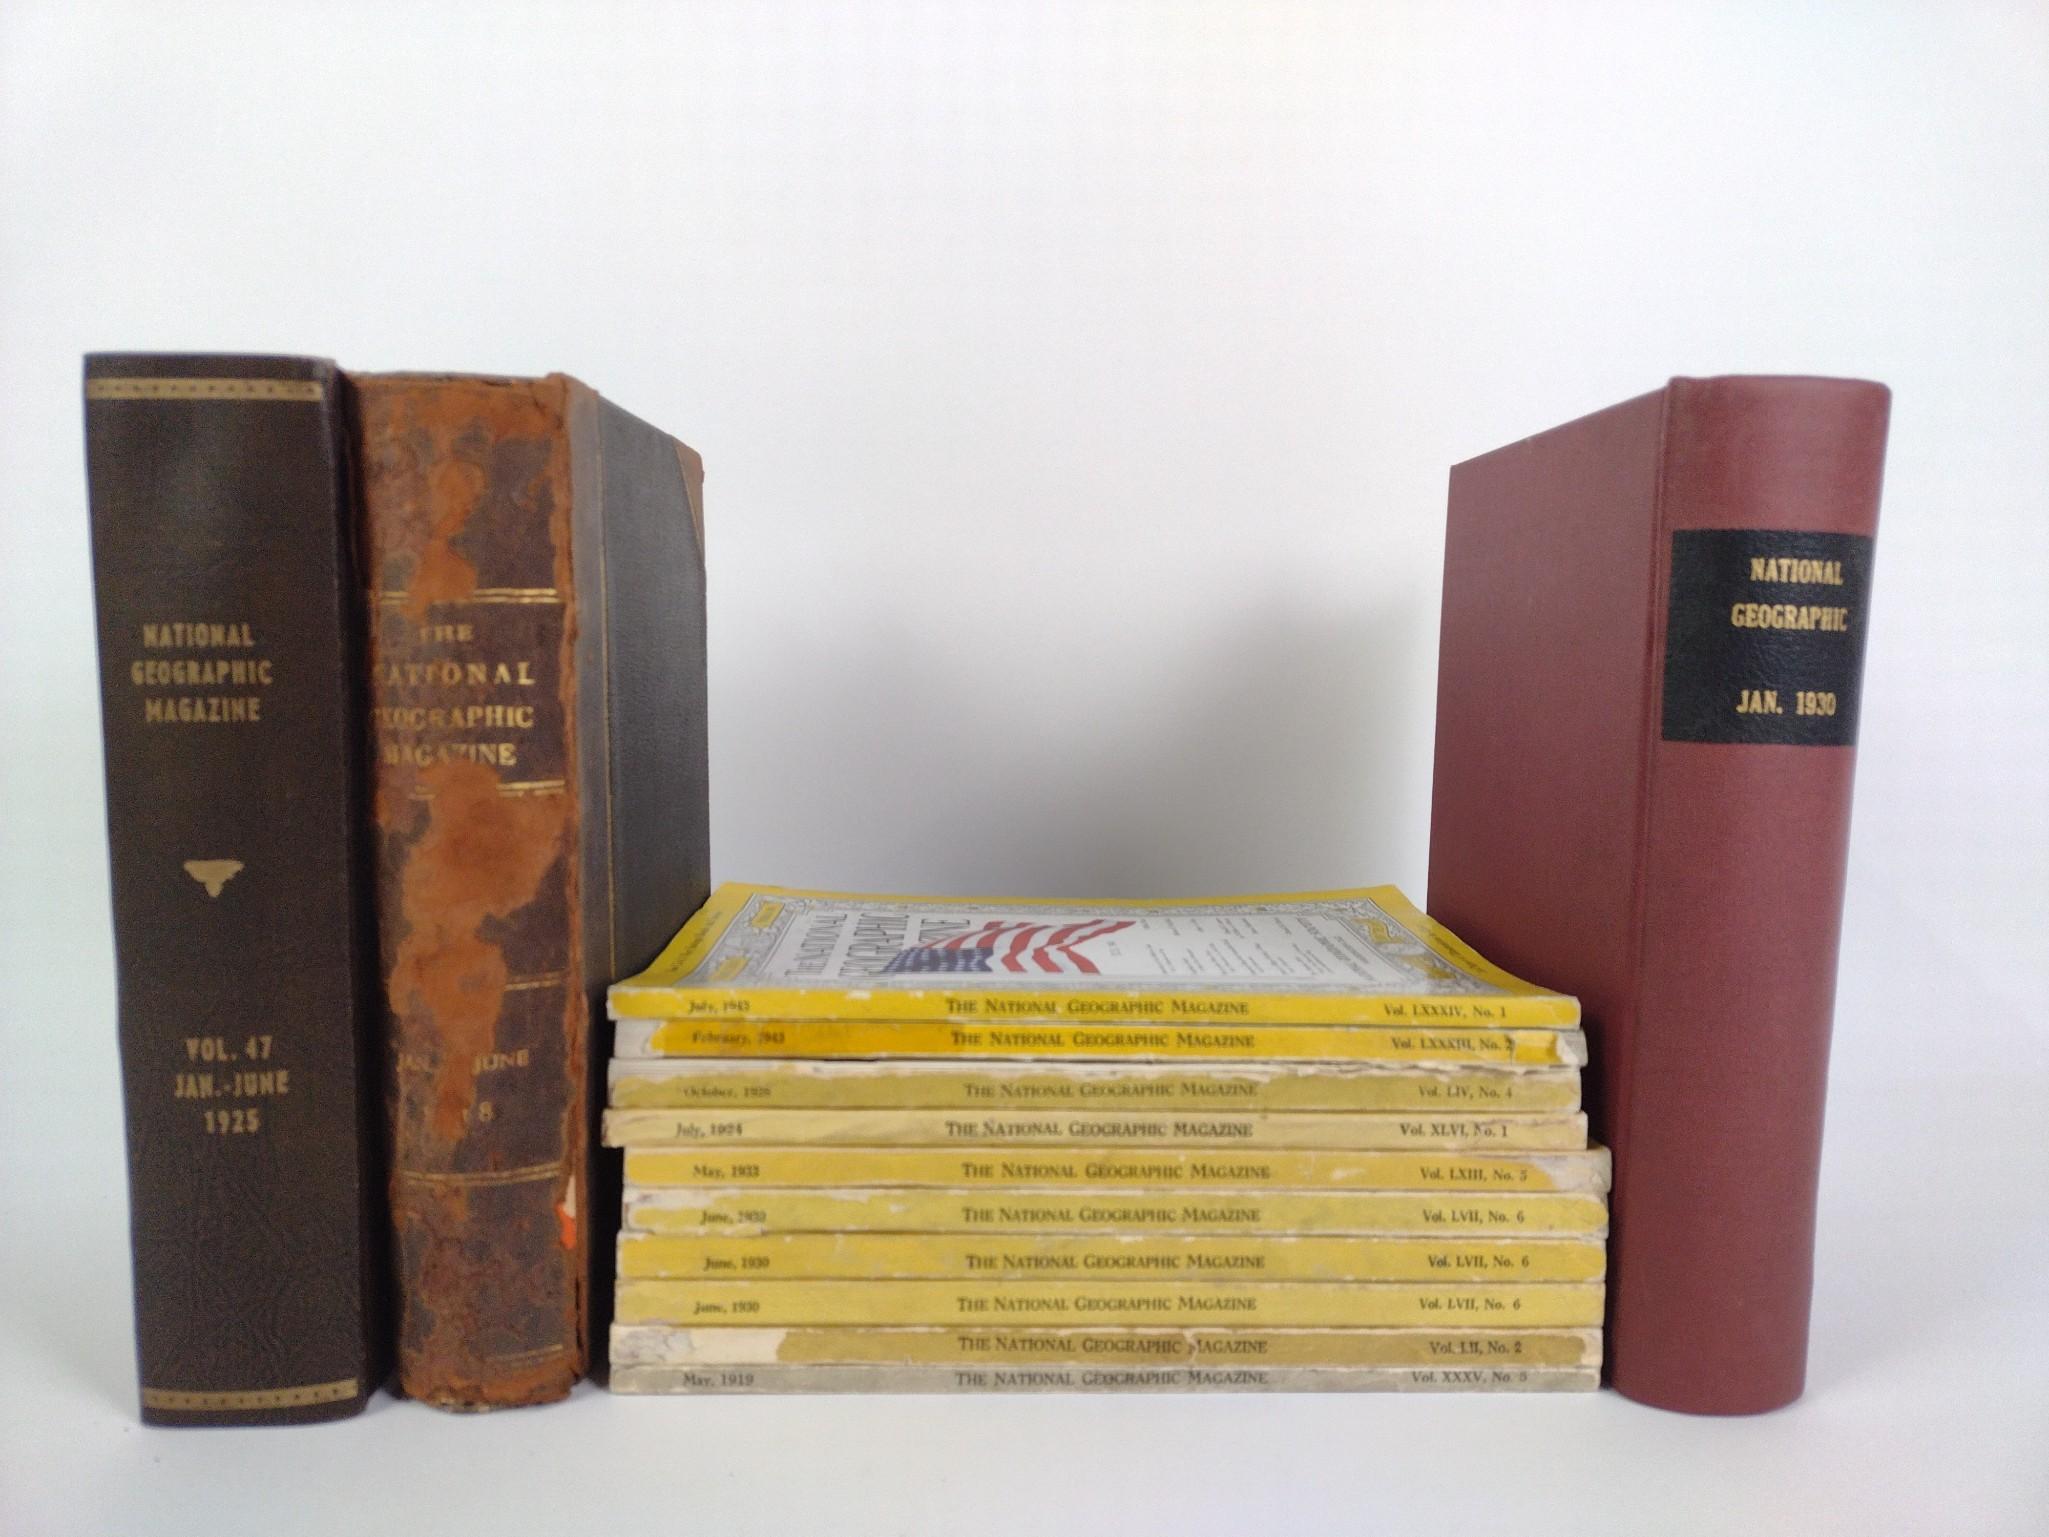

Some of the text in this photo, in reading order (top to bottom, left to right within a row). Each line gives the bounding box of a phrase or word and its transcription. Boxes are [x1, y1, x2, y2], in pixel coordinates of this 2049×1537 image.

[1750, 557, 1843, 585] NATIONAL
[1731, 603, 1848, 632] GEOGRAPHIC
[143, 623, 255, 648] NATIONAL
[131, 660, 273, 685] GEOGRAPHIC
[374, 661, 536, 686] ATIONAL
[145, 697, 260, 722] MAGAZINE
[1736, 689, 1837, 716] JAN. 1930
[946, 999, 976, 1013] THE
[985, 999, 1058, 1014] NATIONAL
[1067, 999, 1163, 1014] GEOGRAPHIC
[1171, 999, 1249, 1015] MAGAZINE
[1384, 1004, 1406, 1016] Vol.
[1413, 1004, 1467, 1018] LXXXIV,
[1473, 1005, 1493, 1017] No.
[1500, 1005, 1507, 1017] 1
[186, 1034, 273, 1061] VOL. 47
[951, 1030, 981, 1047] THE
[990, 1031, 1064, 1047] NATIONAL
[1073, 1031, 1169, 1047] GEOGRAPHIC
[1176, 1032, 1255, 1048] MAGAZINE
[1392, 1037, 1415, 1049] Vol.
[1480, 1038, 1499, 1050] No.
[964, 1083, 994, 1098] THE
[1000, 1084, 1074, 1098] NATIONAL
[1080, 1082, 1174, 1097] GEOGRAPHIC
[1180, 1082, 1258, 1097] MAGAZINE
[1419, 1086, 1440, 1097] Vol.
[1447, 1086, 1473, 1099] LIV,
[1479, 1086, 1499, 1098] No.
[1505, 1086, 1513, 1098] 4
[204, 1108, 261, 1134] 1925
[676, 1122, 705, 1137] July,
[945, 1120, 977, 1136] THE
[983, 1120, 1062, 1136] NATIONAL
[1069, 1120, 1165, 1137] GEOGRAPHIC
[1173, 1122, 1252, 1137] MAGAZINE
[1400, 1124, 1424, 1137] Vol.
[1430, 1124, 1469, 1138] XLVI,
[1473, 1125, 1496, 1137] No.
[1501, 1125, 1508, 1137] 1
[693, 1164, 725, 1179] May,
[961, 1162, 993, 1178] THE
[1002, 1162, 1076, 1178] NATIONAL
[1085, 1163, 1182, 1178] GEOGRAPHIC
[1190, 1163, 1270, 1179] MAGAZINE
[1420, 1168, 1443, 1180] Vol.
[1449, 1168, 1487, 1182] LXIII,
[1493, 1168, 1514, 1180] No.
[1519, 1169, 1527, 1181] 5
[700, 1210, 733, 1224] June,
[962, 1206, 993, 1223] THE
[1000, 1207, 1073, 1223] NATIONAL
[1079, 1207, 1176, 1223] GEOGRAPHIC
[1182, 1207, 1260, 1223] MAGAZINE
[1423, 1210, 1446, 1223] Vol.
[1451, 1210, 1483, 1224] LVII,
[1488, 1210, 1509, 1222] No.
[1516, 1210, 1525, 1222] 6
[704, 1256, 736, 1271] June,
[966, 1254, 997, 1269] THE
[1003, 1254, 1077, 1270] NATIONAL
[1084, 1254, 1180, 1270] GEOGRAPHIC
[1186, 1254, 1265, 1270] MAGAZINE
[1428, 1255, 1451, 1268] Vol.
[1456, 1255, 1488, 1269] LVII,
[1493, 1255, 1514, 1268] No.
[1521, 1255, 1529, 1267] 6
[694, 1302, 727, 1316] June,
[957, 1297, 988, 1312] THE
[994, 1297, 1068, 1312] NATIONAL
[1075, 1297, 1170, 1311] GEOGRAPHIC
[1177, 1296, 1256, 1311] MAGAZINE
[1419, 1298, 1442, 1310] Vol.
[1447, 1298, 1479, 1311] LVII,
[1484, 1298, 1505, 1310] No.
[1512, 1298, 1521, 1310] 6
[958, 1336, 990, 1351] THE
[996, 1336, 1075, 1352] NATIONAL
[1082, 1339, 1180, 1354] GEOGRAPHIC
[1430, 1341, 1454, 1355] Vol.
[1460, 1342, 1485, 1355] LII,
[1488, 1342, 1509, 1354] No.
[1515, 1342, 1523, 1353] 2
[955, 1372, 987, 1386] THE
[994, 1372, 1074, 1386] NATIONAL
[1082, 1371, 1180, 1386] GEOGRAPHIC
[1187, 1370, 1268, 1384] MAGAZINE
[1412, 1371, 1437, 1383] Vol.
[1519, 1371, 1528, 1382] 5
